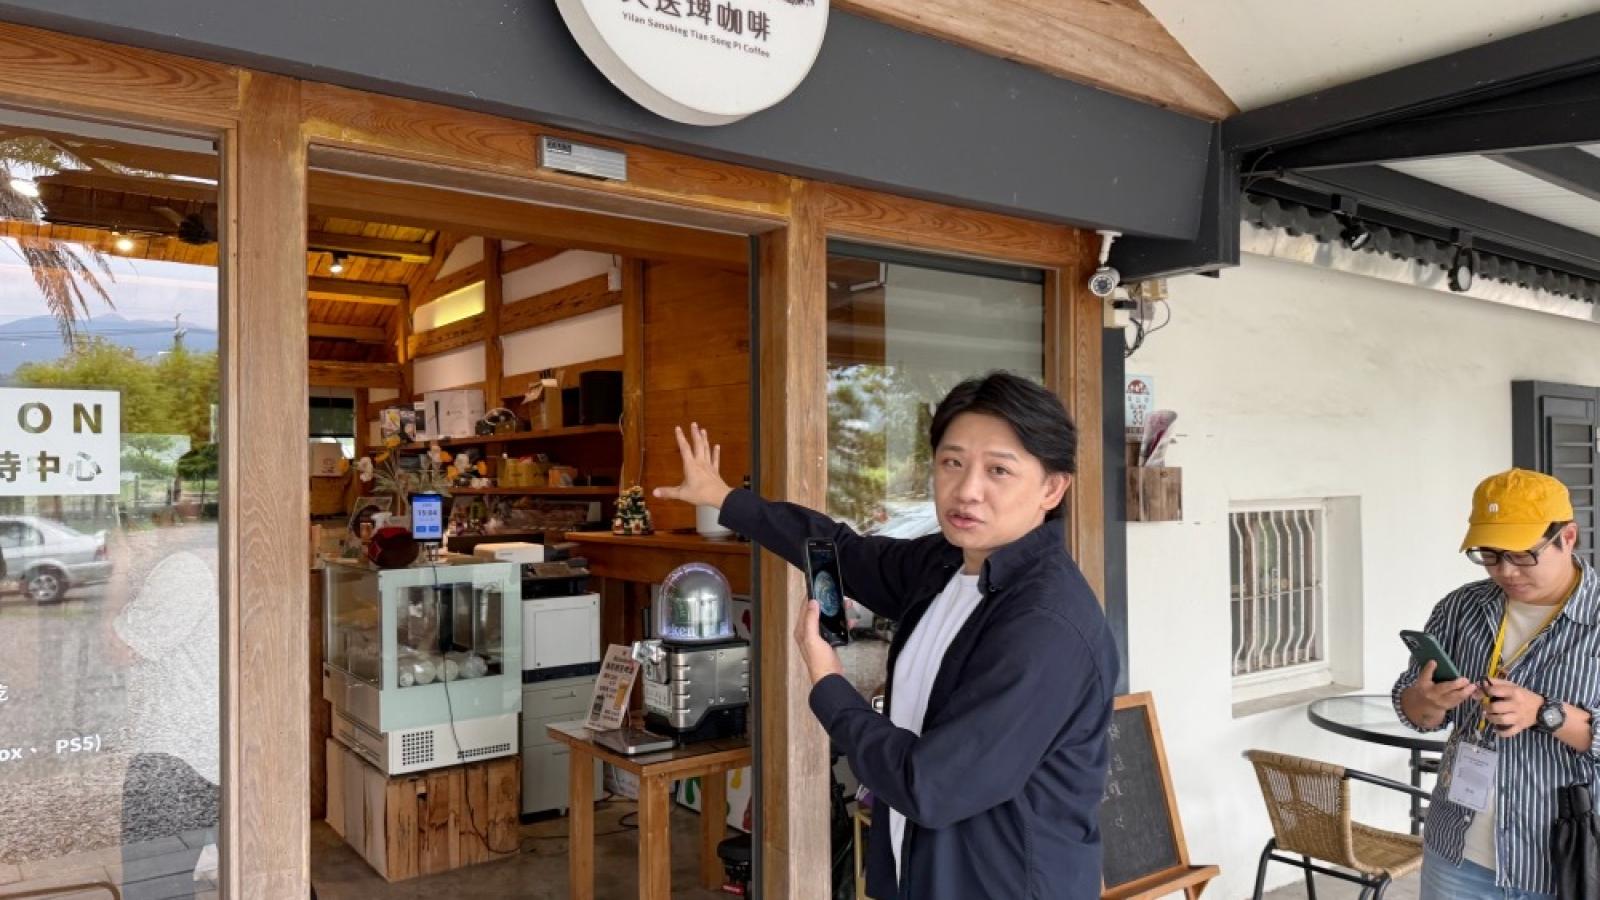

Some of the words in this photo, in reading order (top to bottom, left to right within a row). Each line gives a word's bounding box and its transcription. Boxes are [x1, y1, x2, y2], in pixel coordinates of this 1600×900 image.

[622, 11, 646, 25] Yilan
[648, 18, 688, 37] Sanshing
[690, 30, 708, 41] Tian
[710, 35, 732, 49] Song
[733, 40, 742, 51] Pi
[743, 44, 770, 58] Coffee
[55, 734, 102, 754] PS5)
